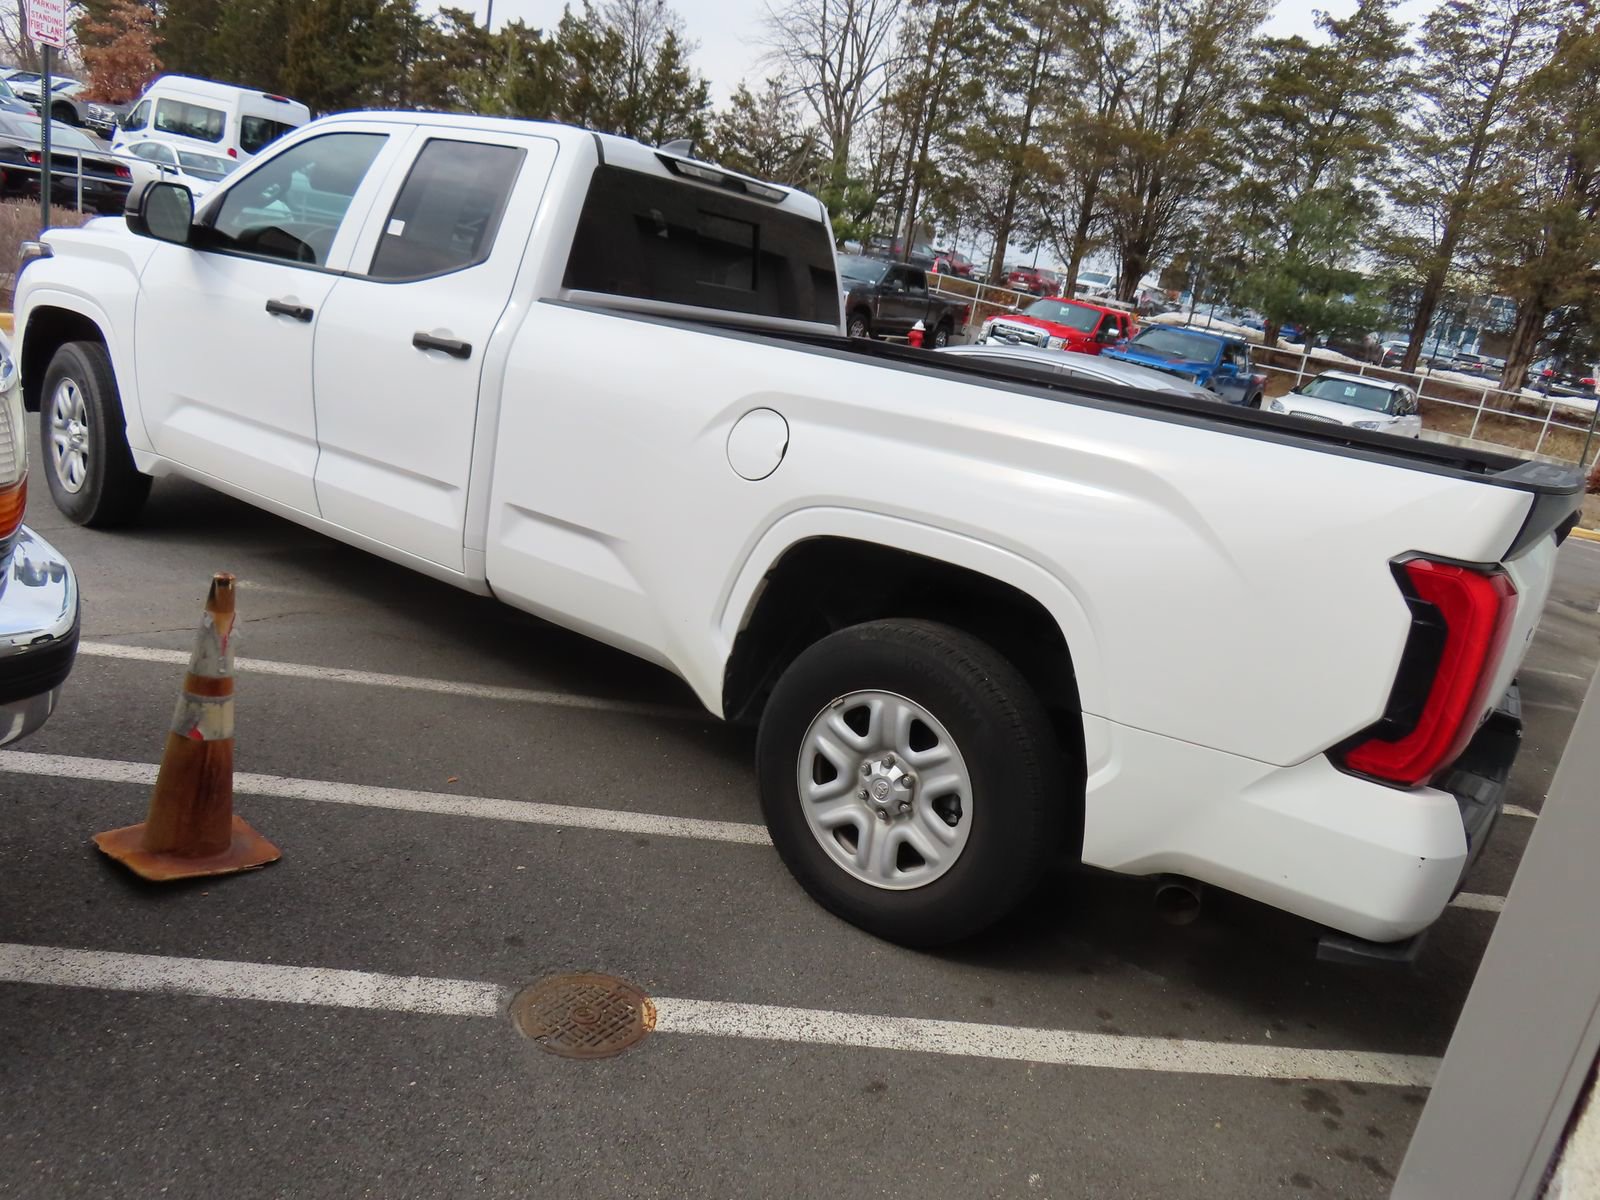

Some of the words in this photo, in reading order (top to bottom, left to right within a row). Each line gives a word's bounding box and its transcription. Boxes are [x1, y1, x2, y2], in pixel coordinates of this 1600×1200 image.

[31, 10, 63, 27] STANDING
[31, 20, 44, 32] FIRE
[46, 24, 63, 37] LANE
